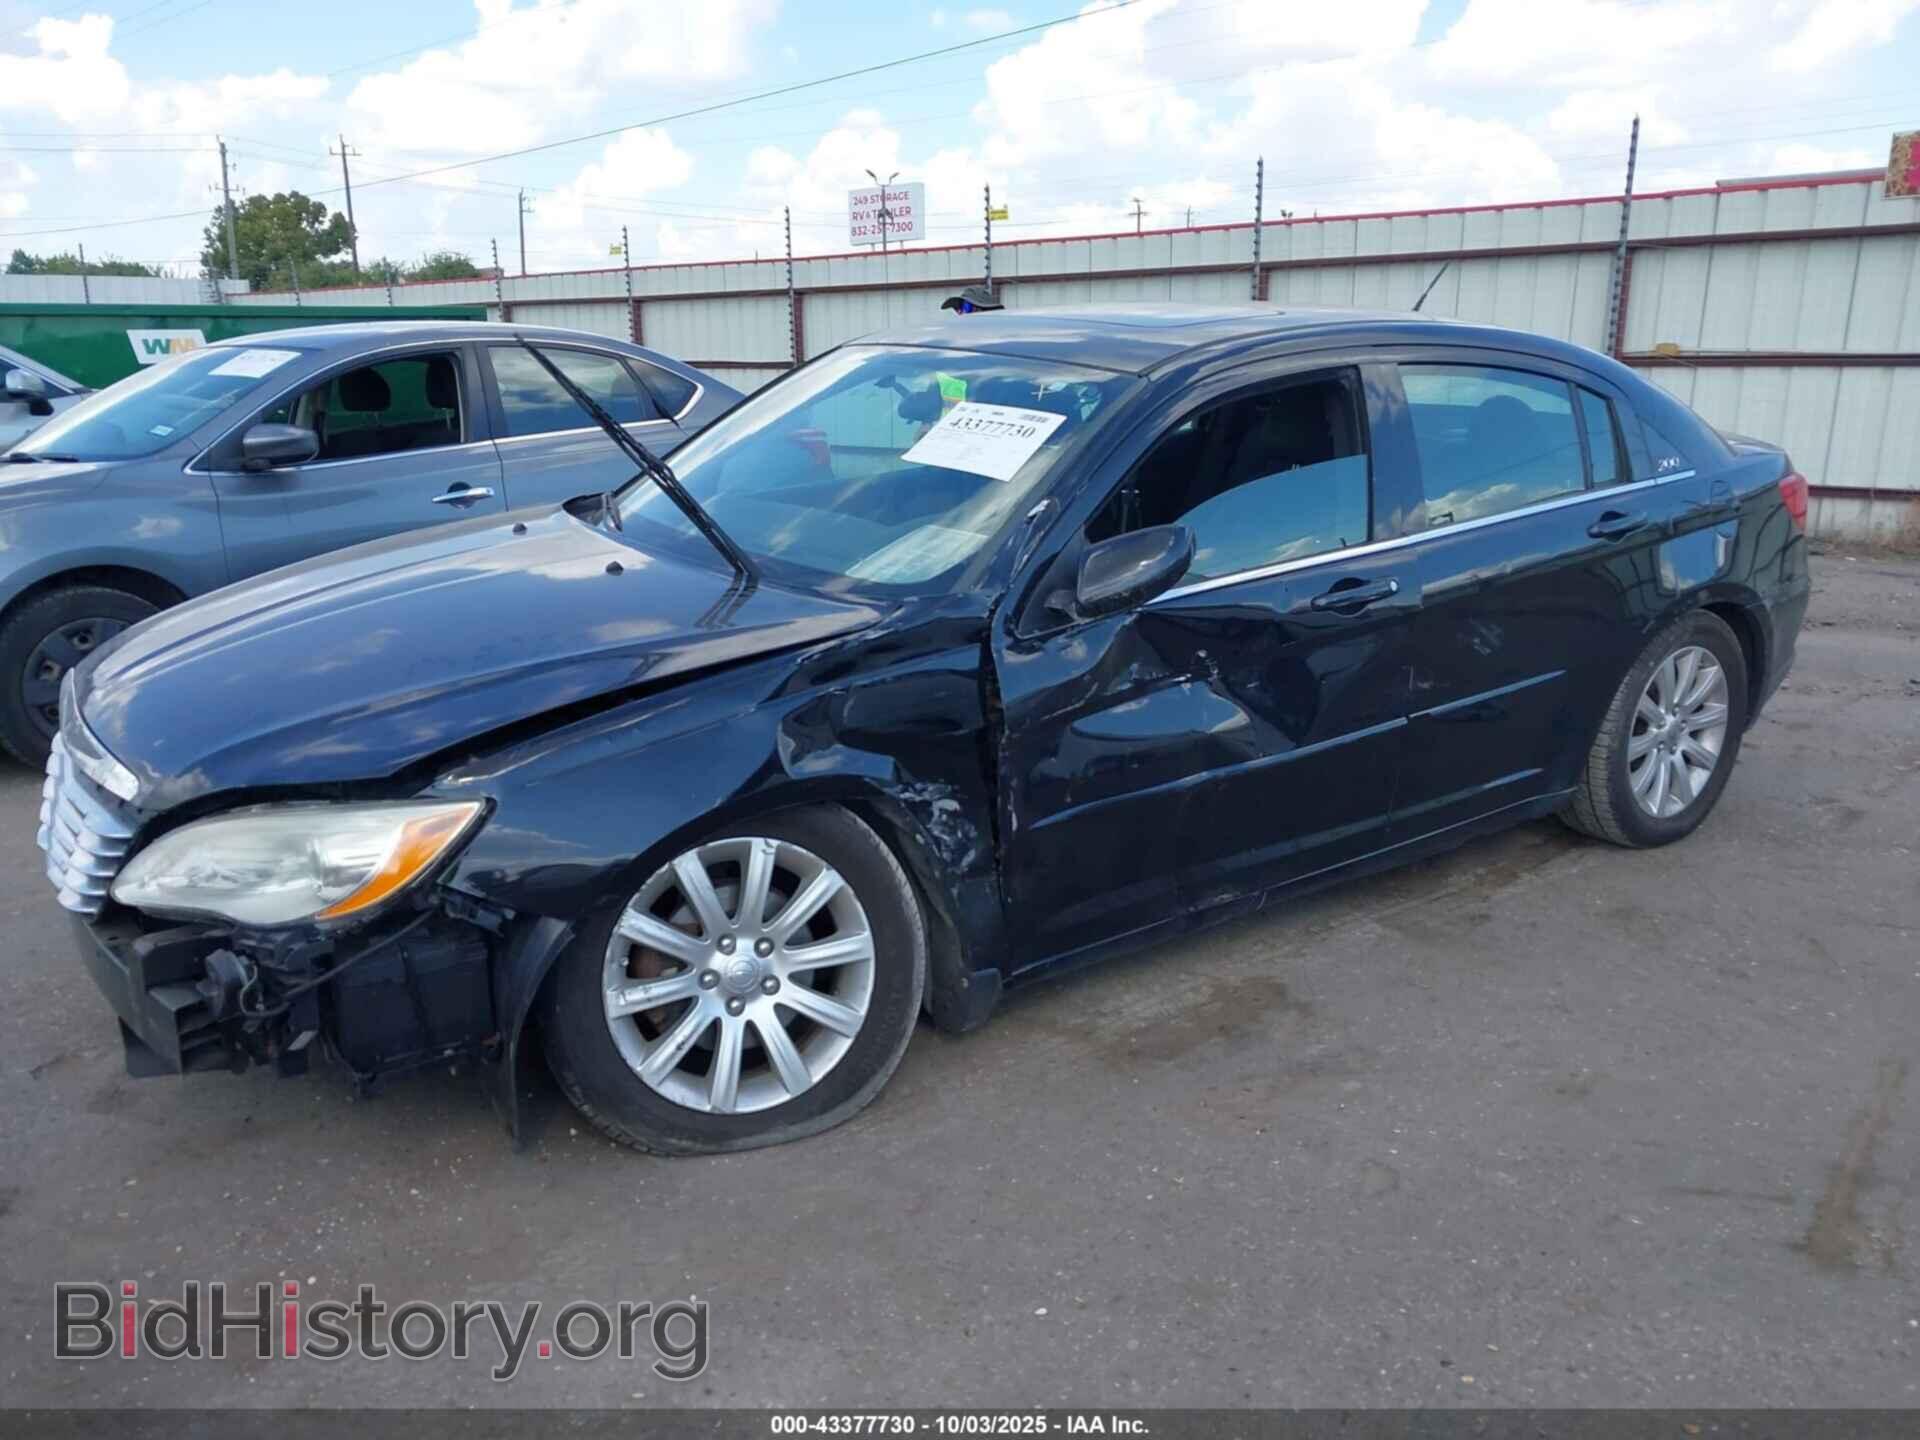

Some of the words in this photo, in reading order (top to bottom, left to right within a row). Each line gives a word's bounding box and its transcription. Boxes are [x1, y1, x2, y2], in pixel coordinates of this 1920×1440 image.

[852, 210, 865, 221] RV
[872, 206, 912, 219] TILER
[851, 221, 913, 237] 832-25-7300
[950, 416, 1036, 439] 43377730
